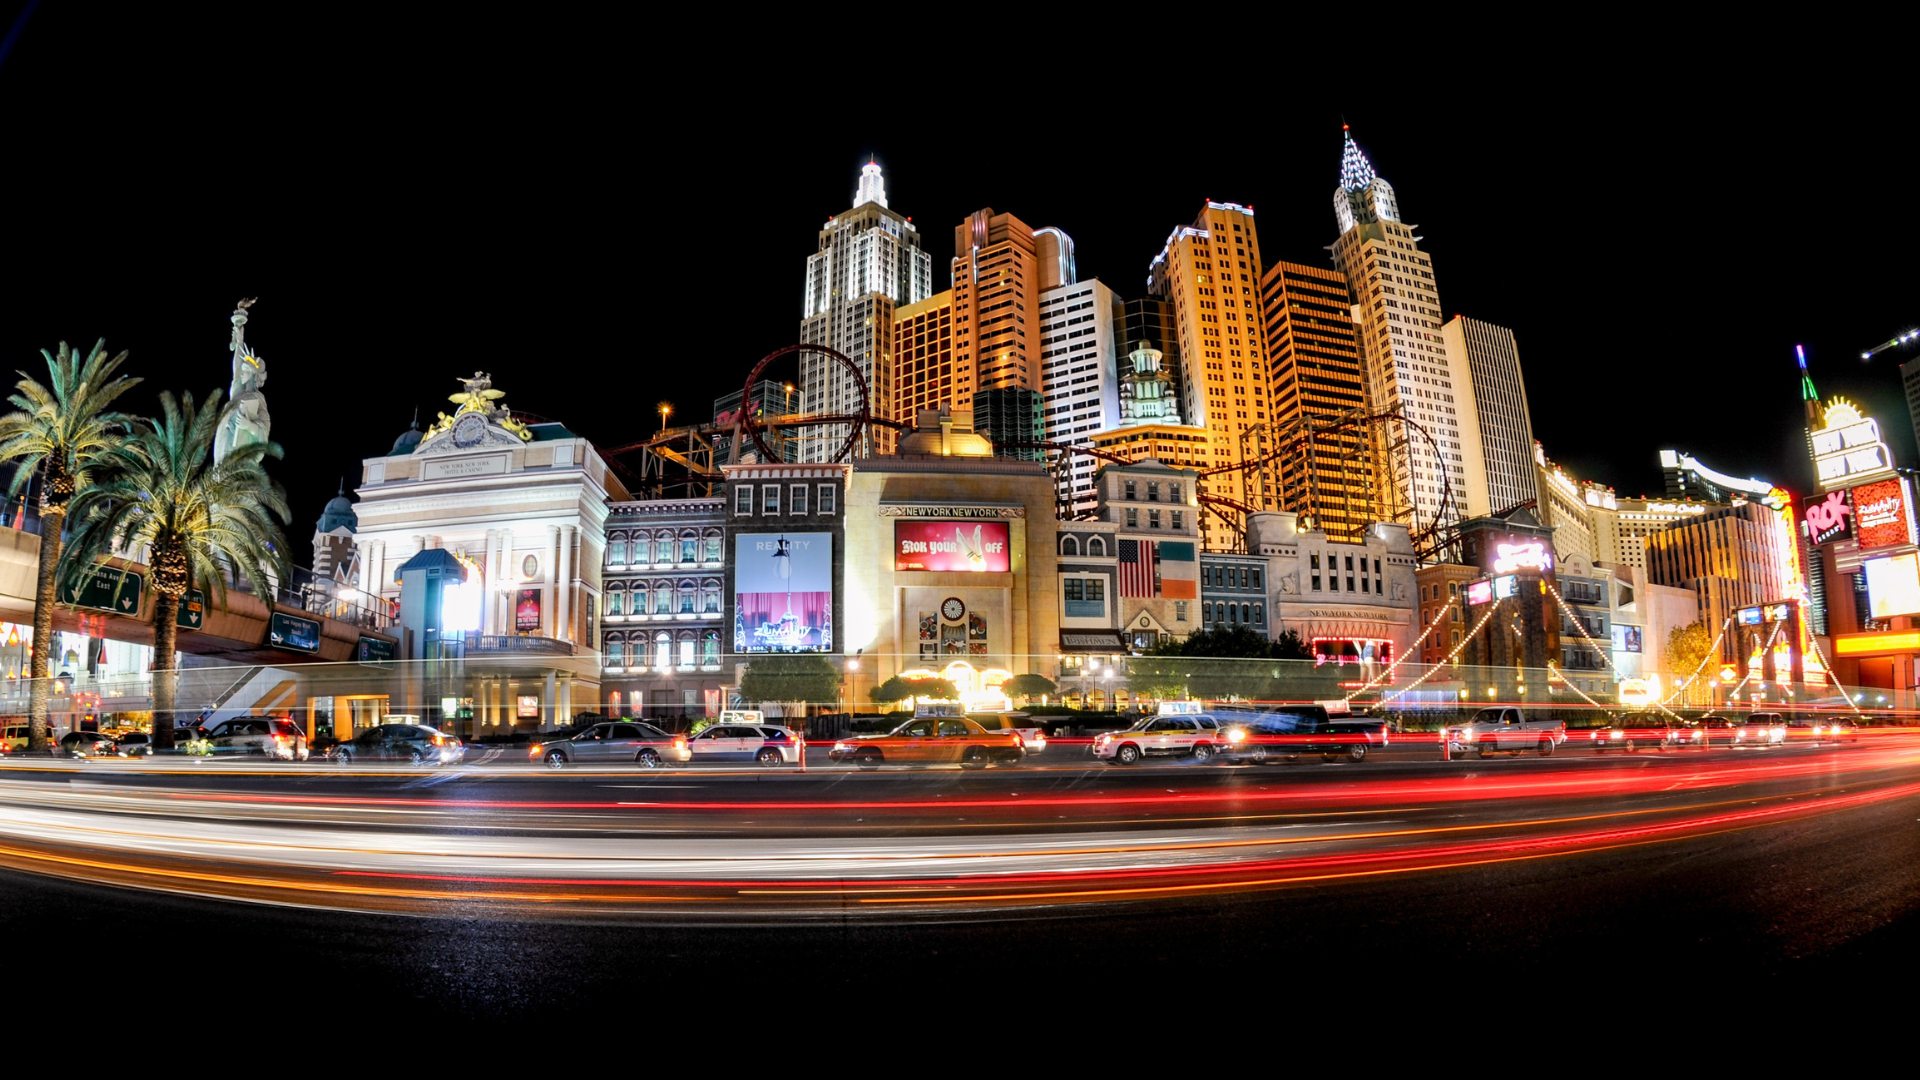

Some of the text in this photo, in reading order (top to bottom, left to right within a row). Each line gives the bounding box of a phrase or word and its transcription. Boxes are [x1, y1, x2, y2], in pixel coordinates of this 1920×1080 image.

[1806, 490, 1850, 545] ROK
[756, 541, 810, 551] REALITY
[985, 543, 1002, 553] OFF
